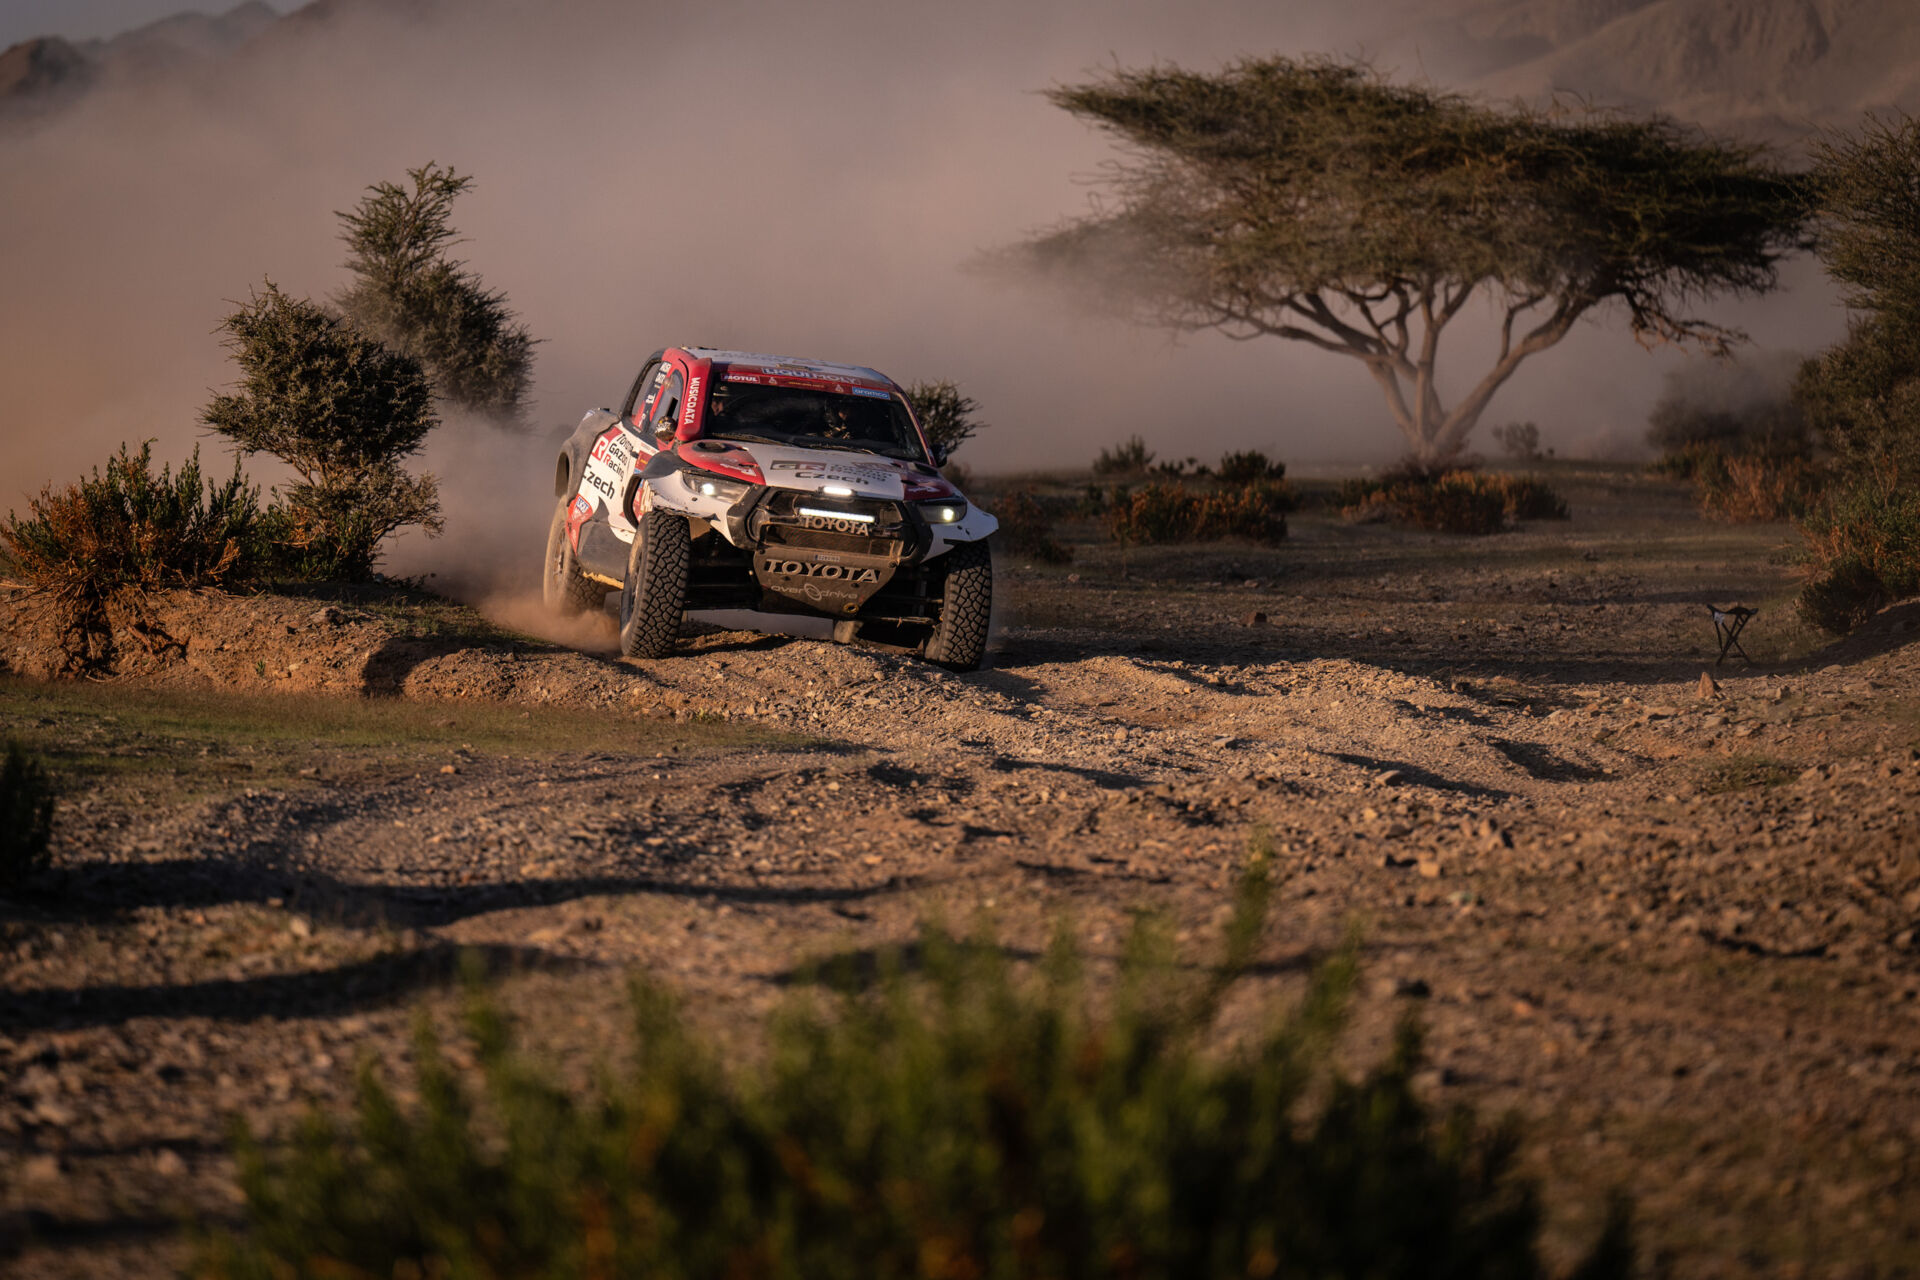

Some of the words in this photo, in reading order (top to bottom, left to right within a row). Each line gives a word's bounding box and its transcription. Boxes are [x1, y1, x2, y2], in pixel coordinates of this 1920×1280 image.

[724, 374, 758, 383] MOTUL
[684, 377, 701, 424] MUSICDATA
[603, 454, 625, 482] Racing
[795, 471, 869, 485] Czech
[800, 515, 869, 536] TOYOTA
[766, 559, 879, 584] TOYOTA
